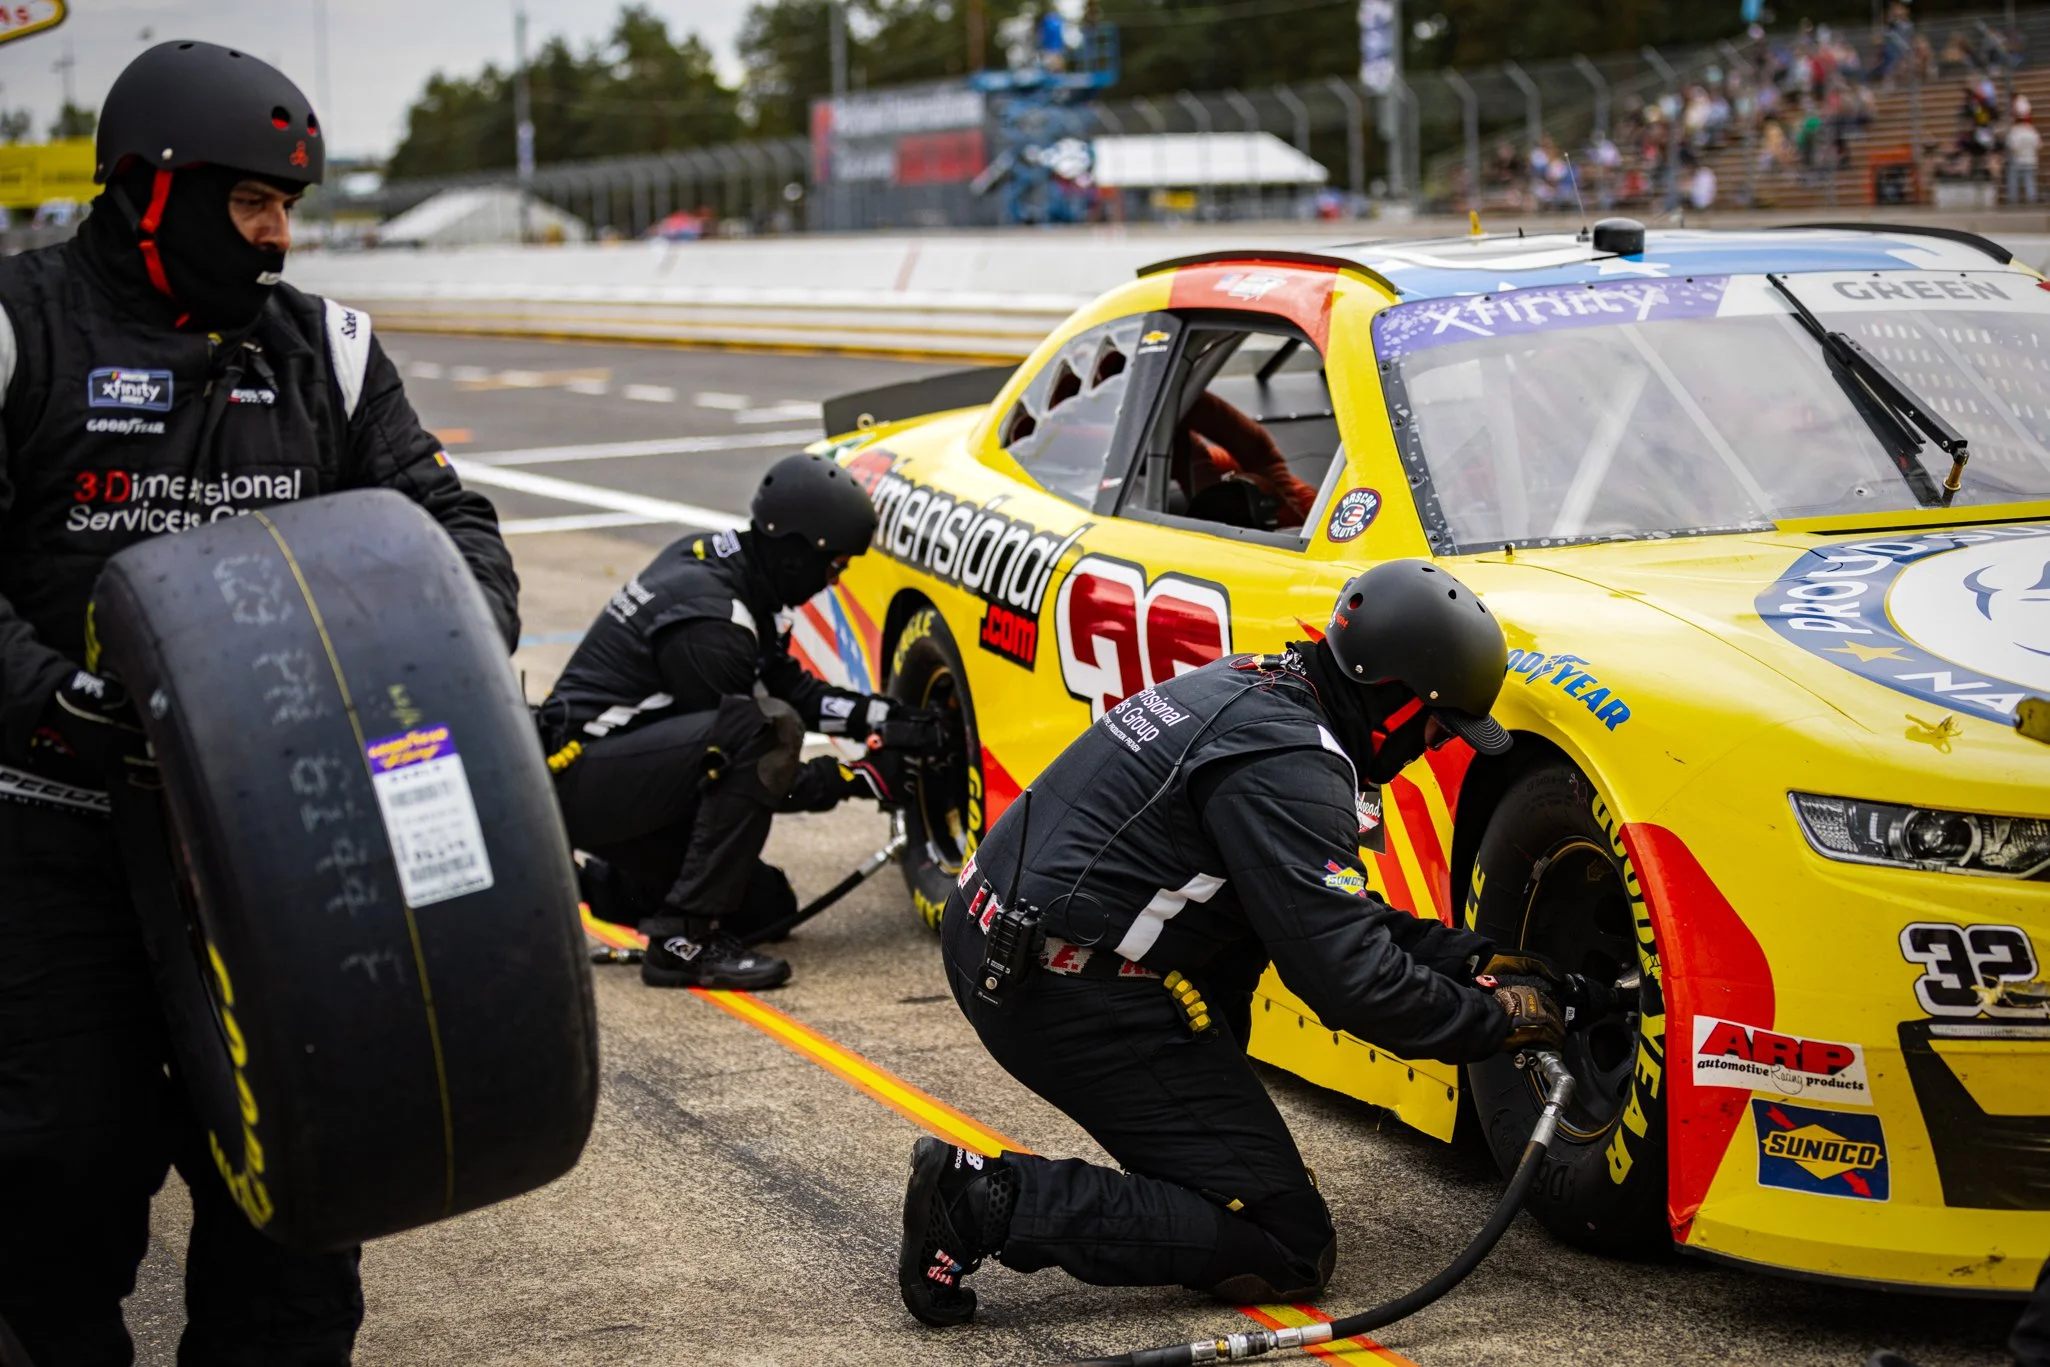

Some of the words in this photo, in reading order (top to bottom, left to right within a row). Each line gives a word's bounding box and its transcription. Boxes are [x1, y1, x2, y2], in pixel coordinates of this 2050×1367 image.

[1832, 280, 2013, 301] GREEN
[102, 379, 161, 402] xfinity
[1342, 491, 1377, 511] NASCAR
[1330, 520, 1364, 538] SALUTES
[1779, 541, 1929, 635] PROUD
[982, 604, 1037, 663] .com
[1507, 648, 1631, 732] ODYEAR
[1121, 707, 1160, 743] Group
[1898, 922, 2050, 1018] 32
[1698, 1021, 1856, 1076] ARP
[1697, 1058, 1769, 1077] automotive
[1806, 1075, 1865, 1091] products
[1769, 1133, 1877, 1166] SUNOCO
